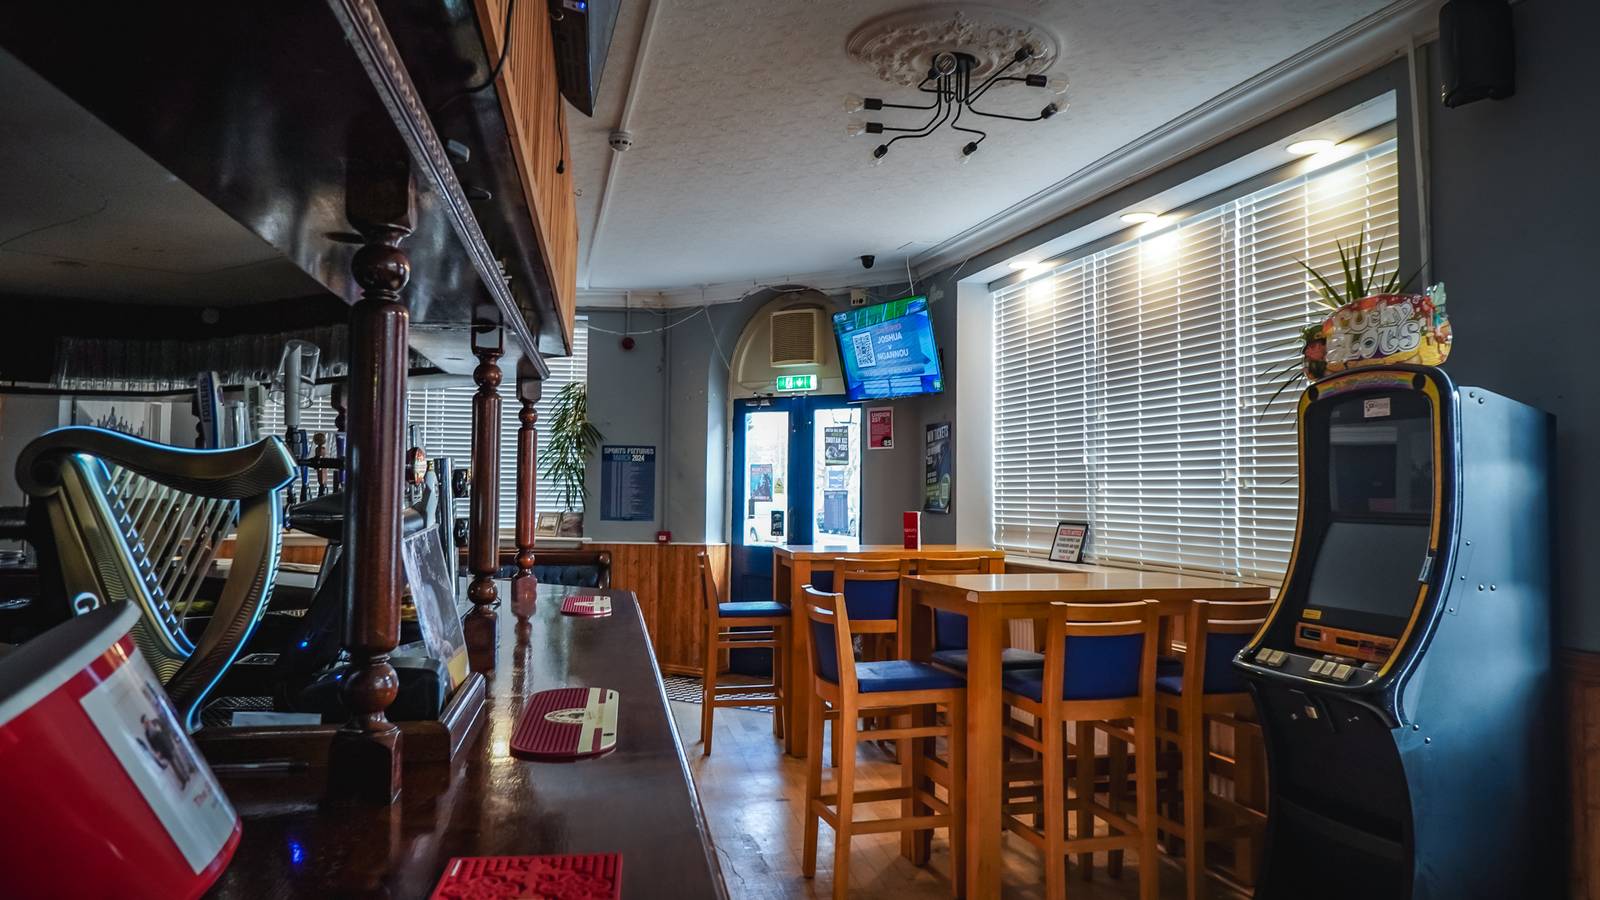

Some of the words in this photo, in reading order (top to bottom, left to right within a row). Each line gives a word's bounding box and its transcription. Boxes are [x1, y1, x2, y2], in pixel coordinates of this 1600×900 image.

[877, 332, 903, 344] JOSHUA
[876, 349, 909, 361] NGANNOU
[632, 454, 645, 462] 2024
